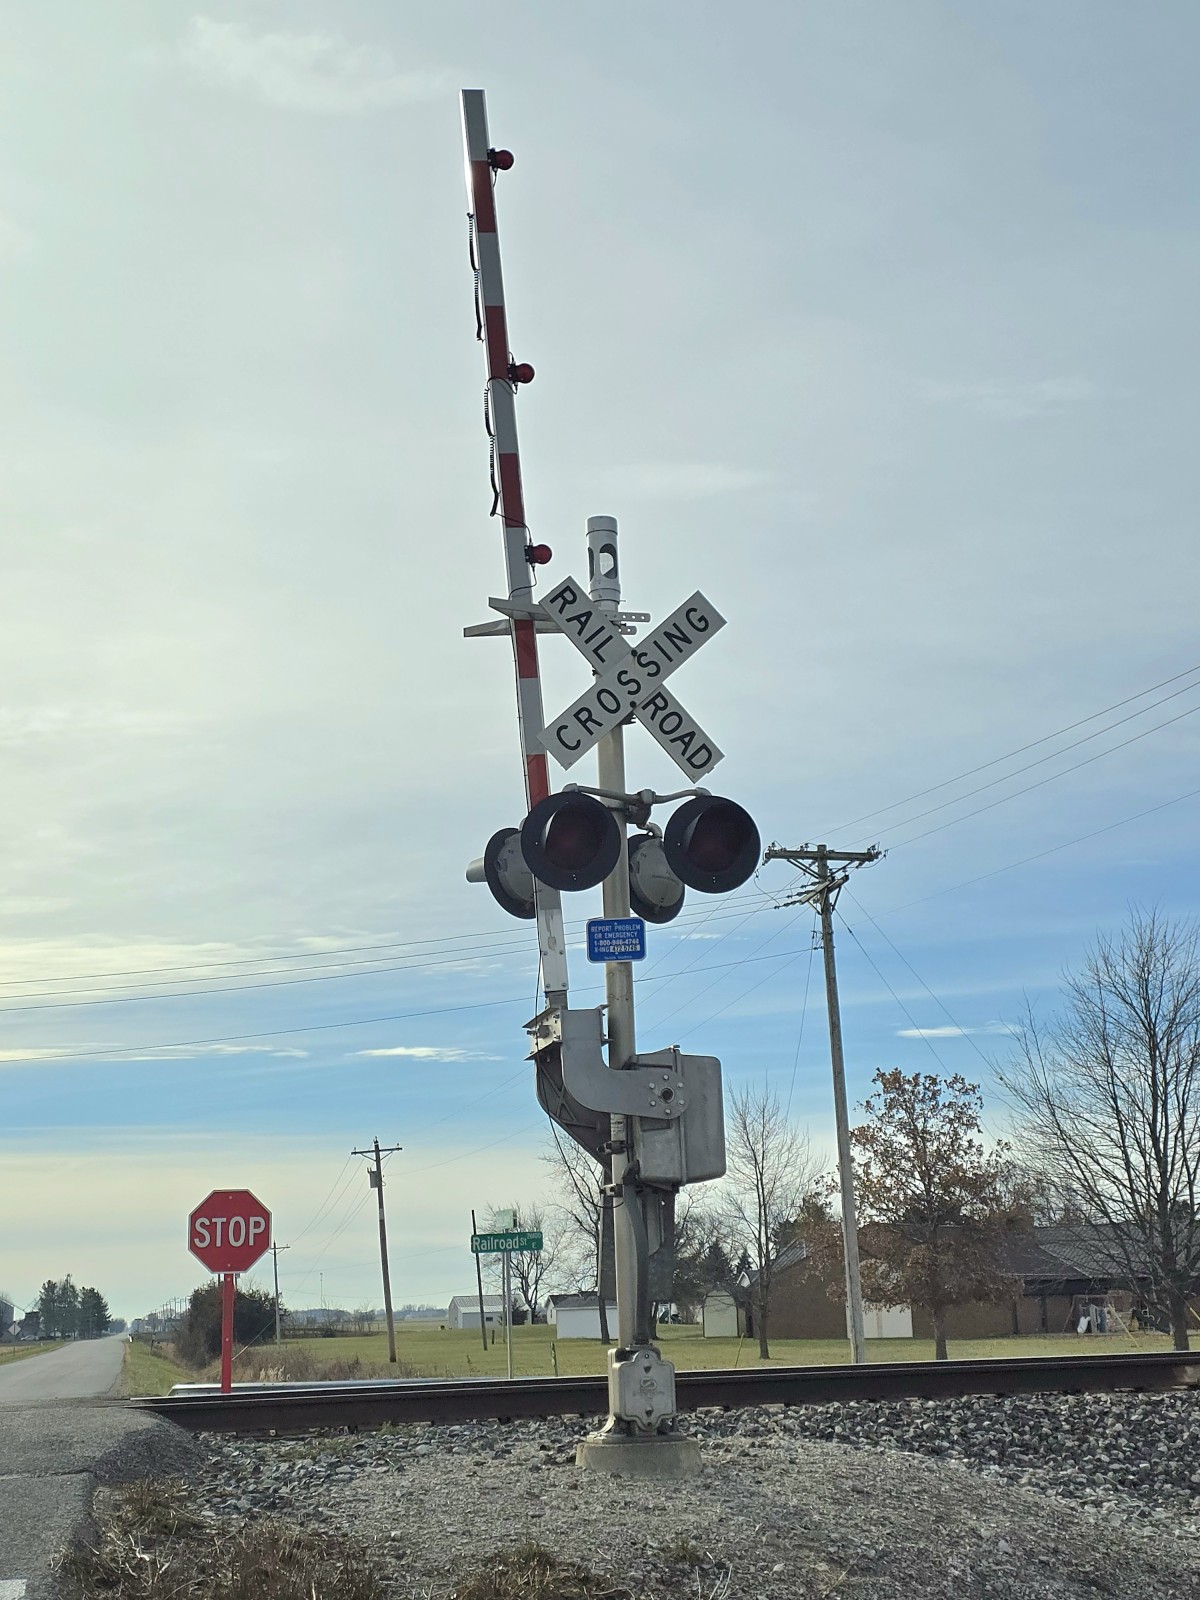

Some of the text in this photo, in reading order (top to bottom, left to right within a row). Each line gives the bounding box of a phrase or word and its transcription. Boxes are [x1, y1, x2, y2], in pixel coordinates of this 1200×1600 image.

[550, 585, 713, 770] RAIL ROAD
[556, 607, 710, 751] CROSSING
[194, 1216, 266, 1248] STOP
[472, 1235, 527, 1251] Railroad St
